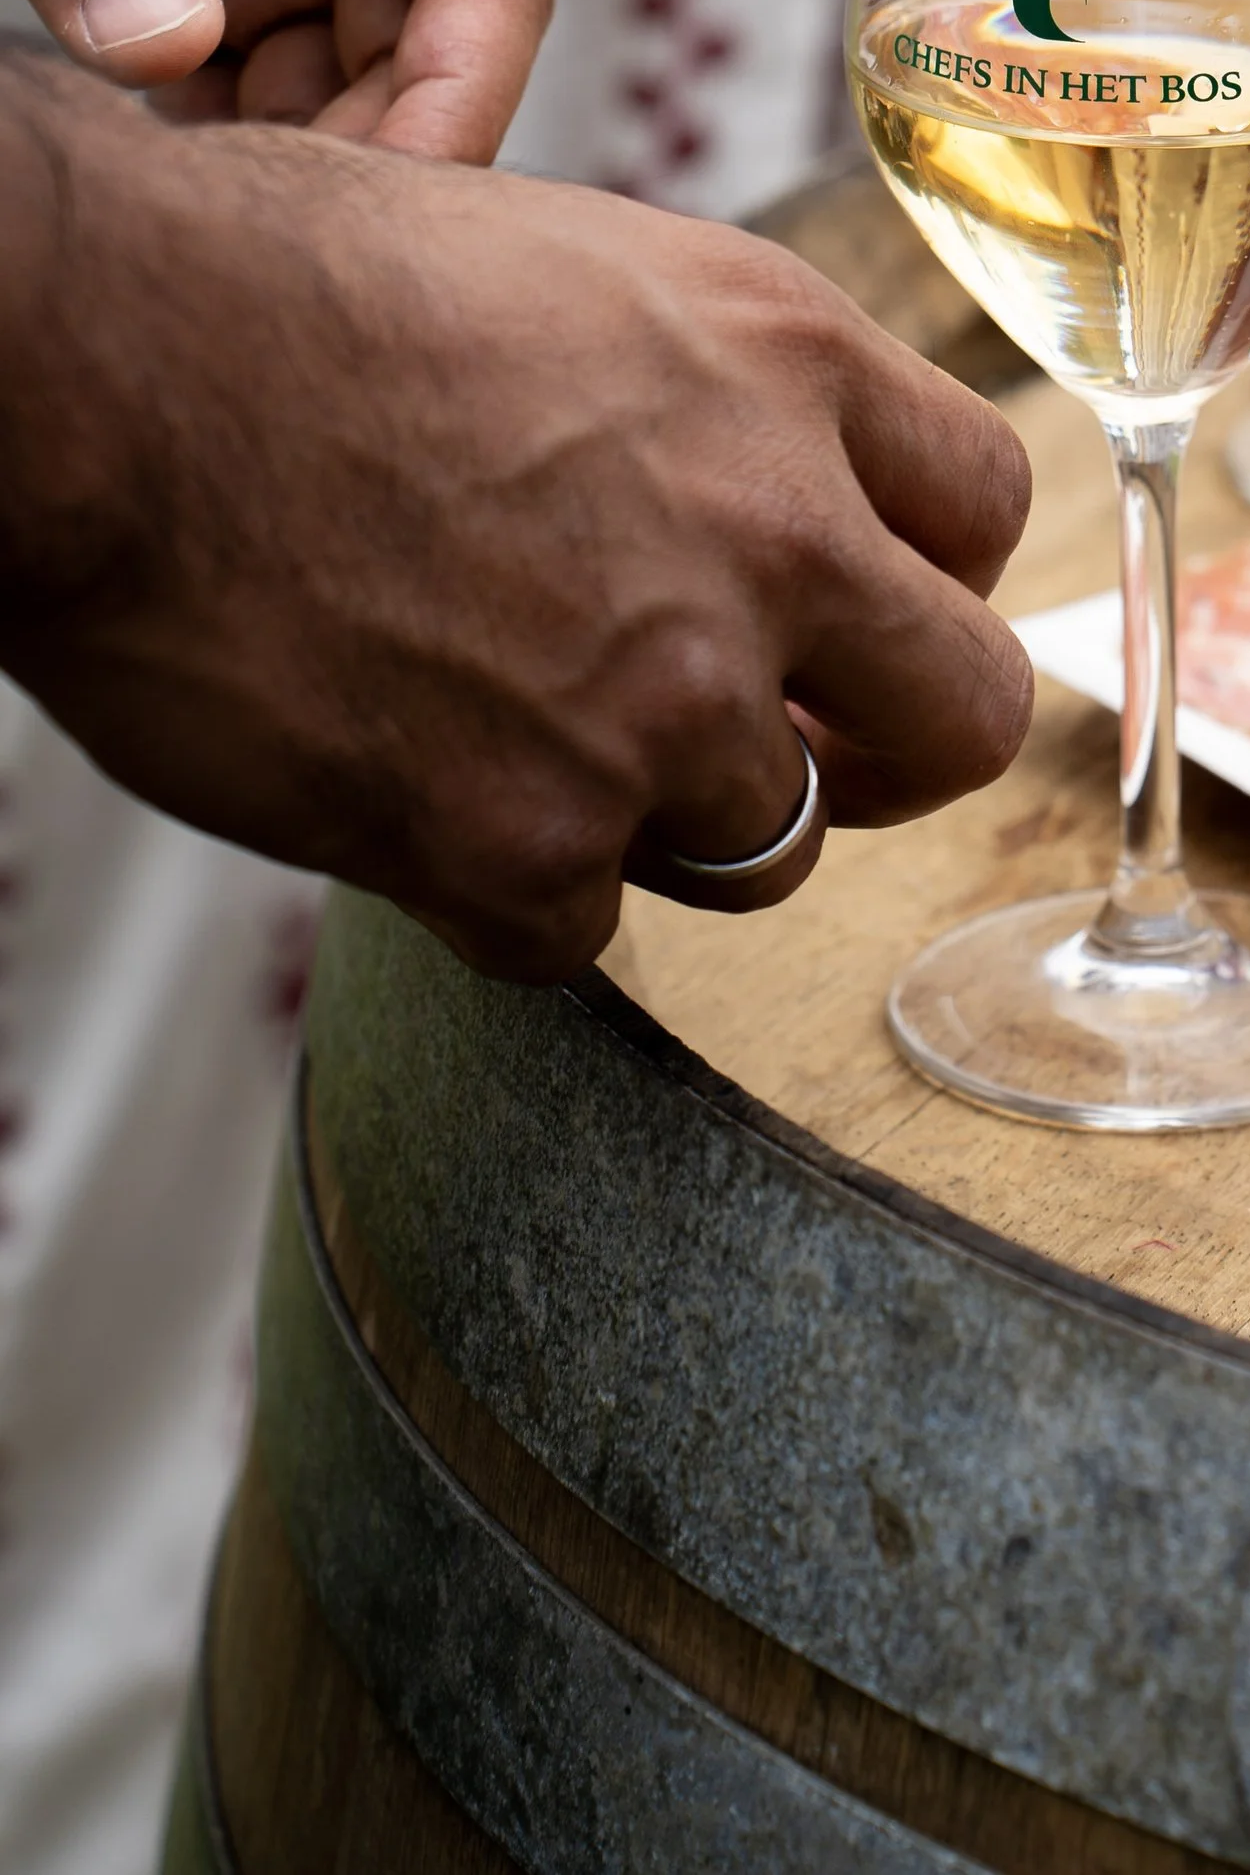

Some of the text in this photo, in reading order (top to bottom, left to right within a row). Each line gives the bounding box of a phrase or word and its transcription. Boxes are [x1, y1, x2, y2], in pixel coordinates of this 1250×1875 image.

[894, 34, 1242, 103] CHEFS IN HET BOS
